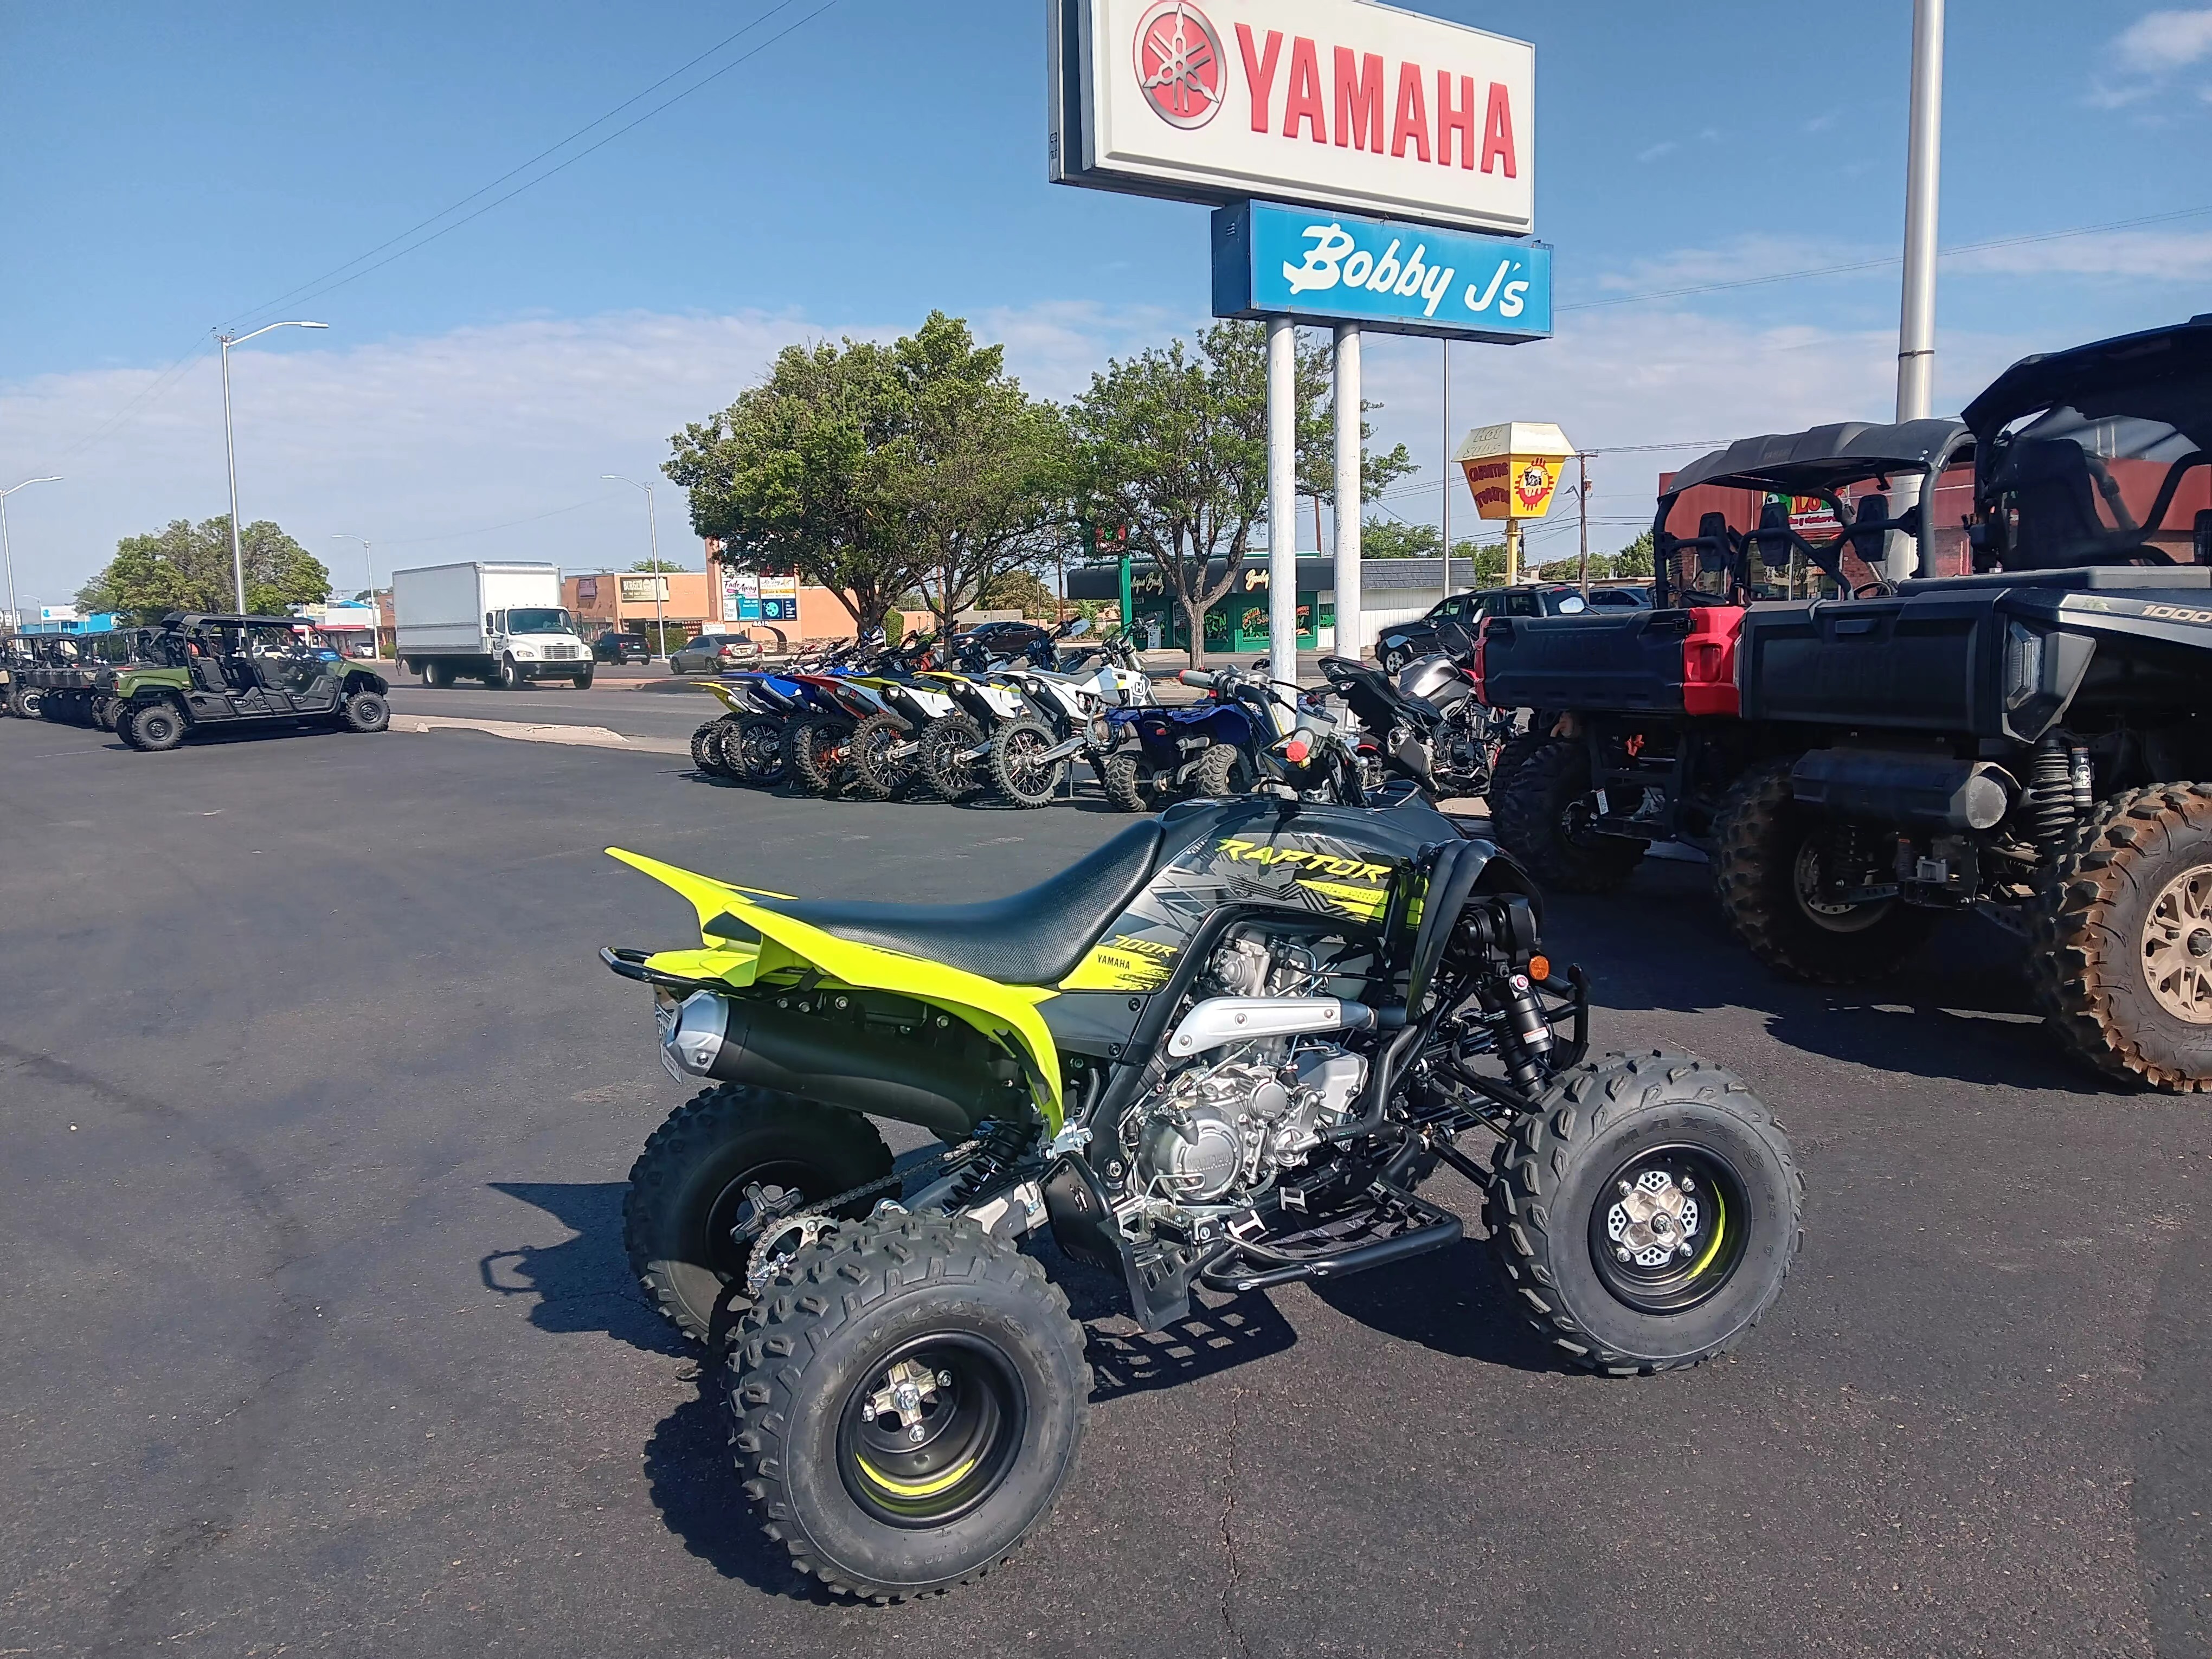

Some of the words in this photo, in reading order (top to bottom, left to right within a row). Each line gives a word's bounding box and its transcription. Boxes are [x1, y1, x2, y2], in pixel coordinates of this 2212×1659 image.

[1234, 22, 1516, 178] YAMAHA
[1283, 223, 1455, 317] Bobby
[1465, 260, 1529, 317] J's
[623, 580, 643, 591] BURGER
[1215, 838, 1392, 884] RAPTOR
[1097, 954, 1130, 970] YAMAHA
[1115, 934, 1178, 958] 700R
[1613, 1115, 1765, 1171] MAXXIS
[838, 1300, 1030, 1378] MAXXIS
